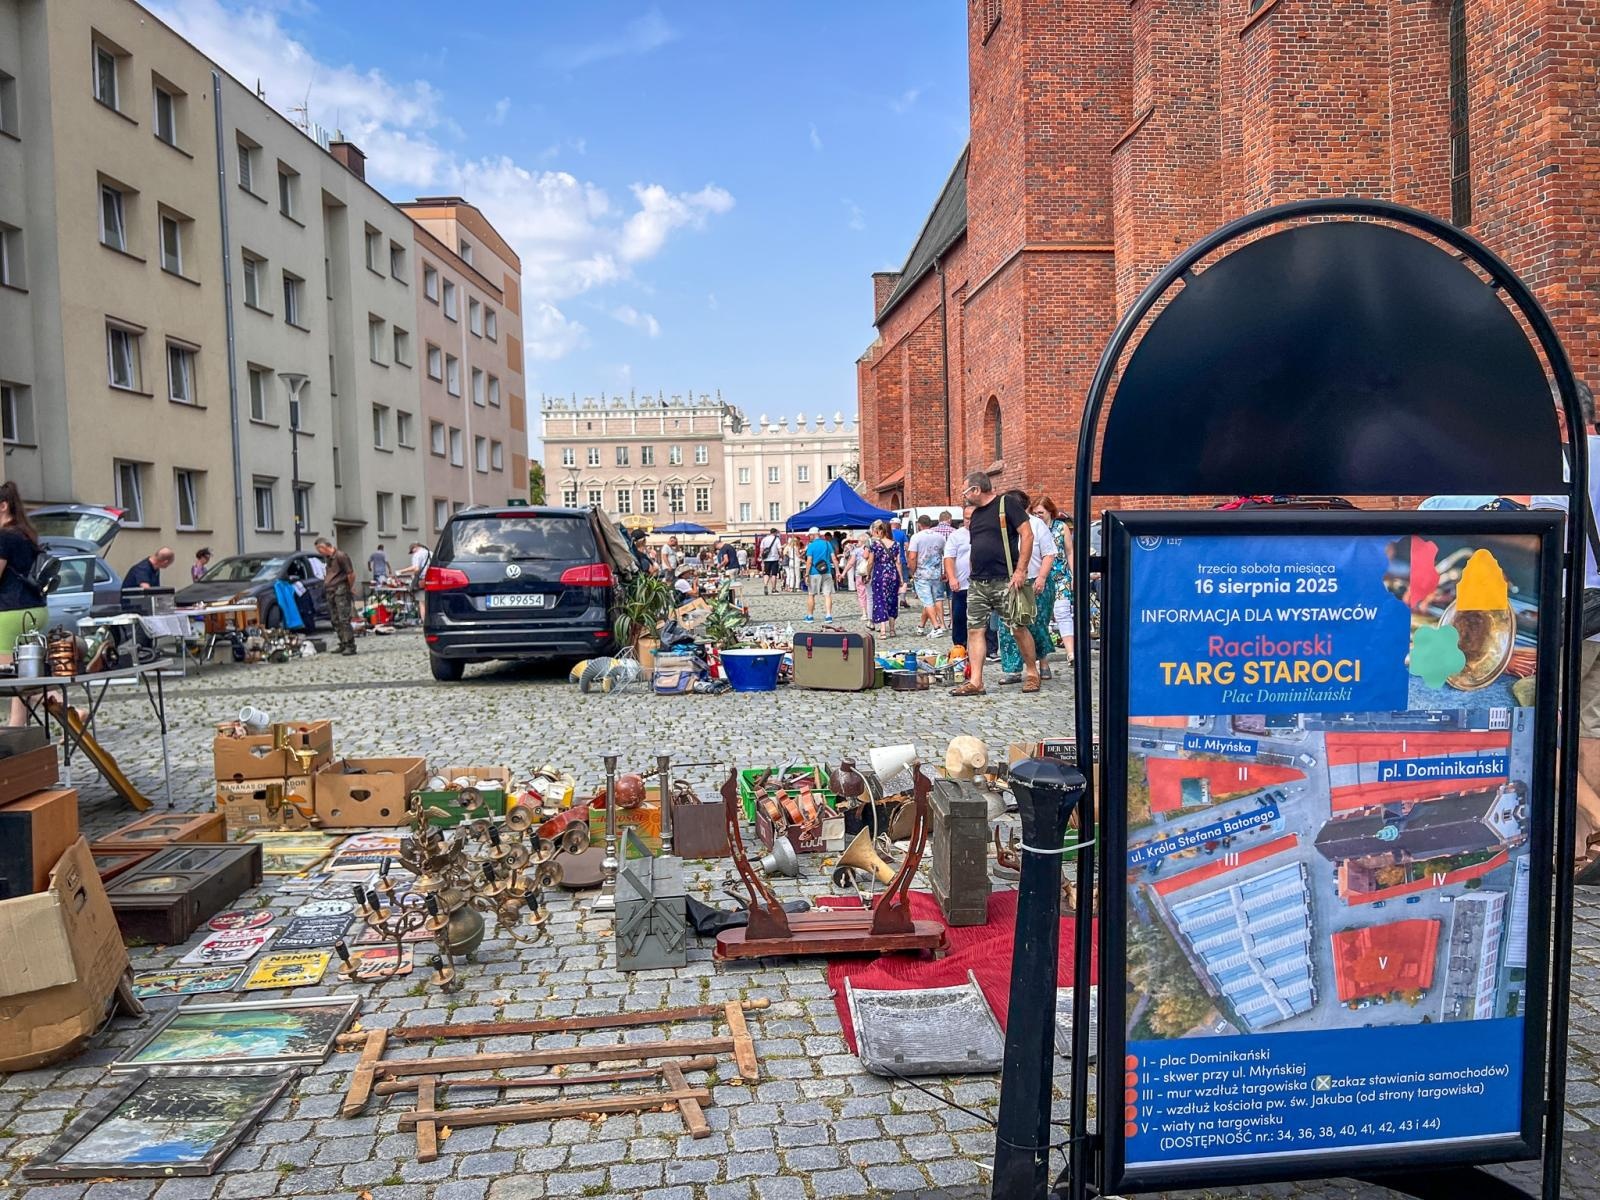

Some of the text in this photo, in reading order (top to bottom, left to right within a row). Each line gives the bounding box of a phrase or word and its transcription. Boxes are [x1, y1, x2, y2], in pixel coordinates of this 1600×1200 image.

[1166, 538, 1182, 546] 1217
[1198, 563, 1335, 576] trzecia sobota miesiąca
[1194, 577, 1338, 597] 16 sierpnia 2025
[510, 595, 541, 605] 99654
[1141, 604, 1377, 626] INFORMACJA DLA WYSTAWCÓW
[1208, 633, 1332, 657] Raciborski
[1159, 659, 1361, 685] TARG STAROCI
[1222, 686, 1352, 703] Plac Dominikański
[1188, 738, 1251, 753] ul. Młyńska
[1402, 738, 1407, 753] I
[1238, 767, 1248, 781] II
[1383, 759, 1504, 781] pl. Dominikański
[1131, 810, 1275, 863] ul. Króla Stefana Batorego
[1224, 852, 1239, 866] III
[1432, 872, 1447, 886] IV
[270, 953, 321, 962] MINEN
[1378, 956, 1388, 970] V
[1160, 1054, 1186, 1069] plac
[1190, 1049, 1270, 1065] Dominikański
[1142, 1073, 1150, 1084] II
[1163, 1071, 1199, 1083] skwer
[1202, 1070, 1229, 1085] przy
[1232, 1066, 1246, 1078] ul.
[1250, 1063, 1306, 1080] Młyńskiej
[1142, 1089, 1153, 1101] III
[1167, 1088, 1192, 1099] mur
[1195, 1084, 1238, 1097] wzdłuż
[1242, 1080, 1307, 1095] targowiska
[1369, 1072, 1425, 1085] stawiania
[1428, 1064, 1509, 1081] samochodów)
[1142, 1105, 1153, 1117] IV
[1166, 1102, 1210, 1115] wzdłuż
[1213, 1099, 1263, 1112] kościoła
[1266, 1100, 1287, 1110] pw.
[1290, 1096, 1309, 1107] św.
[1310, 1093, 1353, 1109] Jakuba
[1356, 1090, 1376, 1104] (od
[1379, 1089, 1414, 1102] strony
[1418, 1082, 1484, 1099] targowiska)
[1141, 1122, 1149, 1134] V
[1162, 1120, 1195, 1134] wiaty
[1199, 1121, 1214, 1130] na
[1217, 1114, 1283, 1132] targowisku
[1160, 1131, 1252, 1151] (DOSTĘPNOŚĆ
[1255, 1131, 1274, 1143] nr.:
[1277, 1130, 1295, 1142] 34,
[1298, 1128, 1315, 1140] 36,
[1319, 1126, 1336, 1138] 38,
[1340, 1124, 1357, 1136] 40,
[1360, 1123, 1375, 1135] 41,
[1379, 1121, 1396, 1133] 42,
[1398, 1120, 1413, 1131] 43
[1422, 1117, 1441, 1130] 44)
